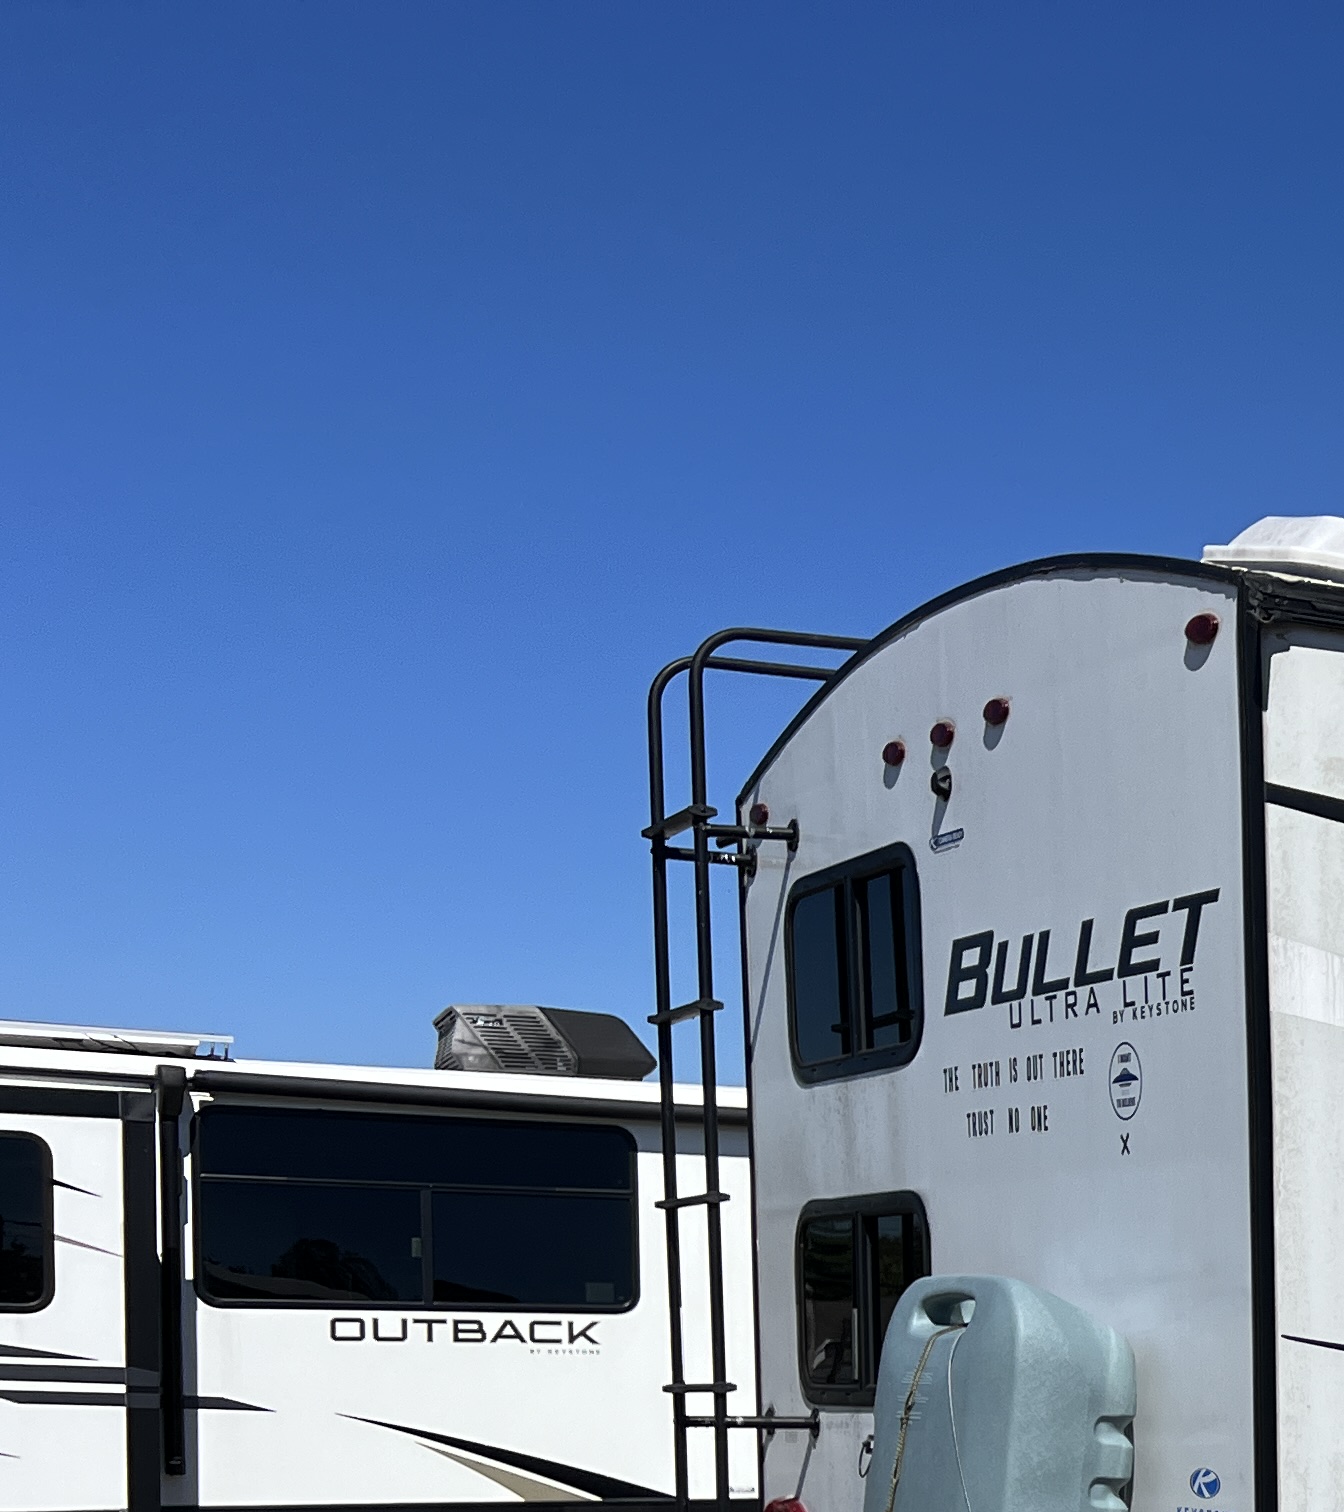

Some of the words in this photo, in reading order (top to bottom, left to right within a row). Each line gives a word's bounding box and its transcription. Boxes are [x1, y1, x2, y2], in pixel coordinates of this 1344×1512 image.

[944, 887, 1220, 1017] BULLET
[1009, 986, 1100, 1029] ULTRA
[1122, 967, 1194, 1008] LITE
[1112, 1010, 1125, 1024] BY
[1132, 996, 1195, 1020] KEYSTONE
[943, 1065, 960, 1093] THE
[971, 1060, 1001, 1089] TRUTH
[1009, 1056, 1018, 1083] IS
[1026, 1053, 1044, 1082] OUT
[1052, 1047, 1085, 1075] THERE
[966, 1109, 995, 1138] TRUST
[1008, 1107, 1020, 1134] NO
[1030, 1104, 1049, 1132] ONE
[1119, 1132, 1131, 1156] X
[330, 1317, 600, 1345] OUTBACK
